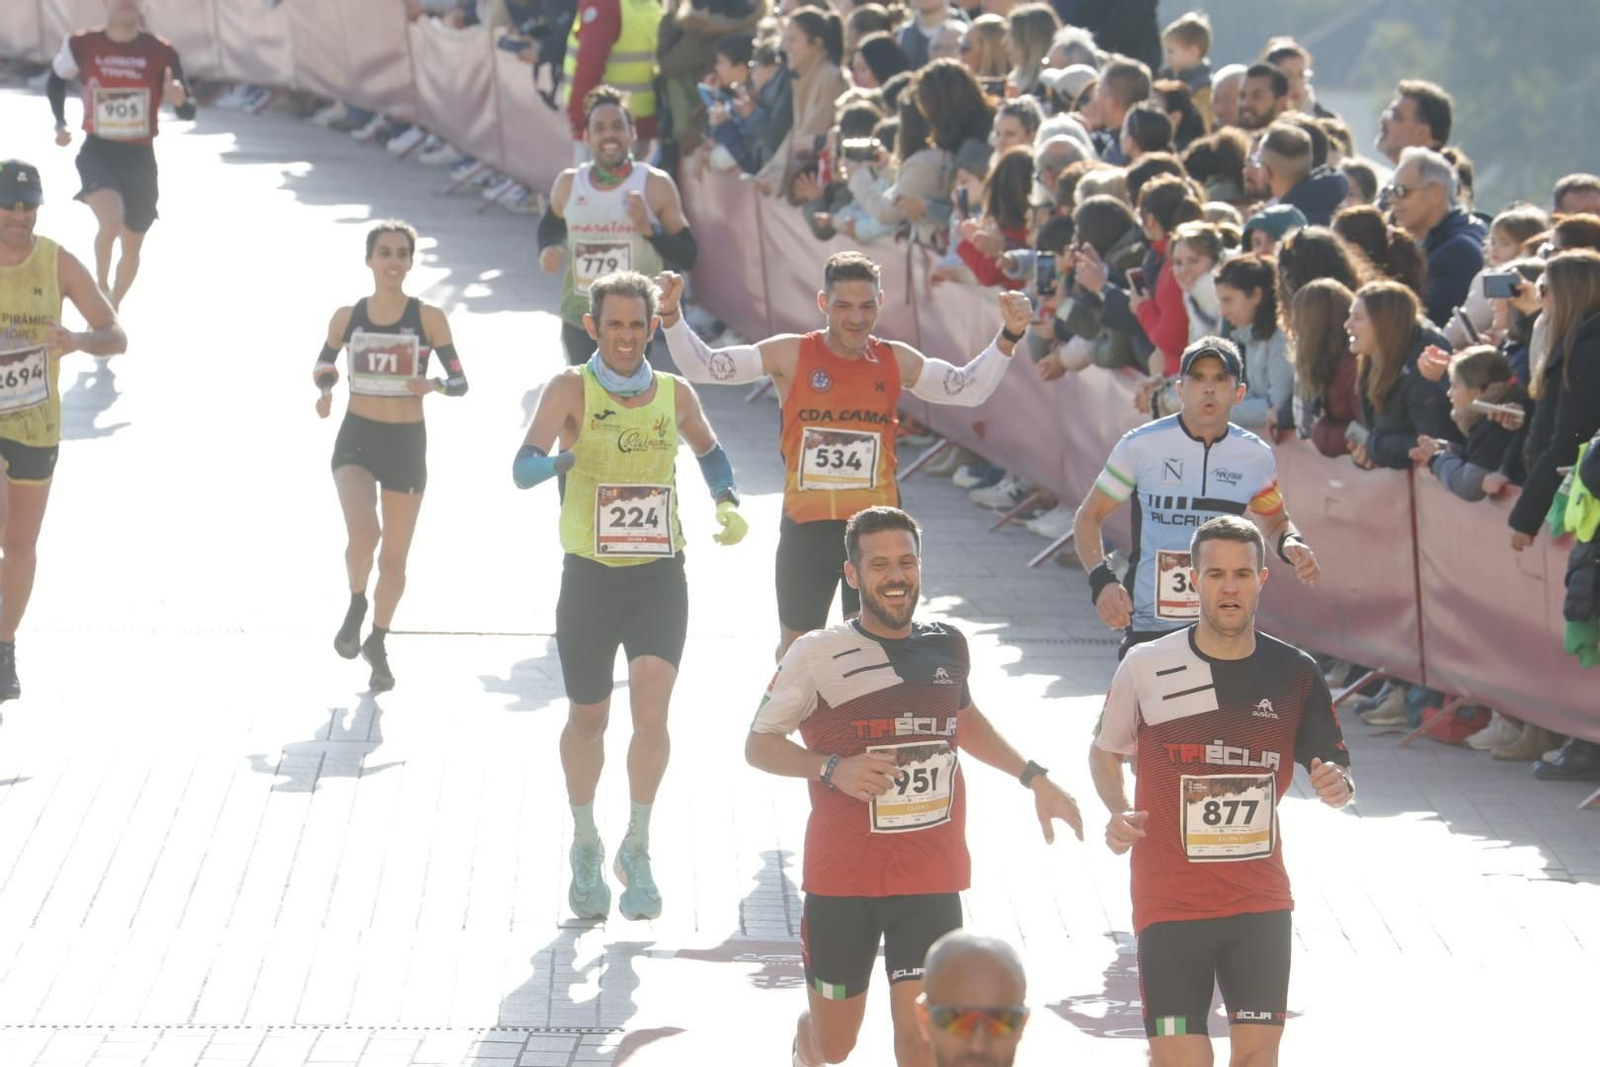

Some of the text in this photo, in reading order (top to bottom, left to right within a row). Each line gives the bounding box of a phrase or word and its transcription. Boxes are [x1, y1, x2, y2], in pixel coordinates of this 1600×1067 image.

[105, 101, 138, 118] 905
[583, 257, 618, 273] 779
[367, 352, 397, 372] 171
[798, 409, 833, 421] CDA
[815, 449, 862, 471] 534
[609, 506, 658, 528] 224
[894, 767, 938, 795] 951
[1203, 800, 1259, 825] 877
